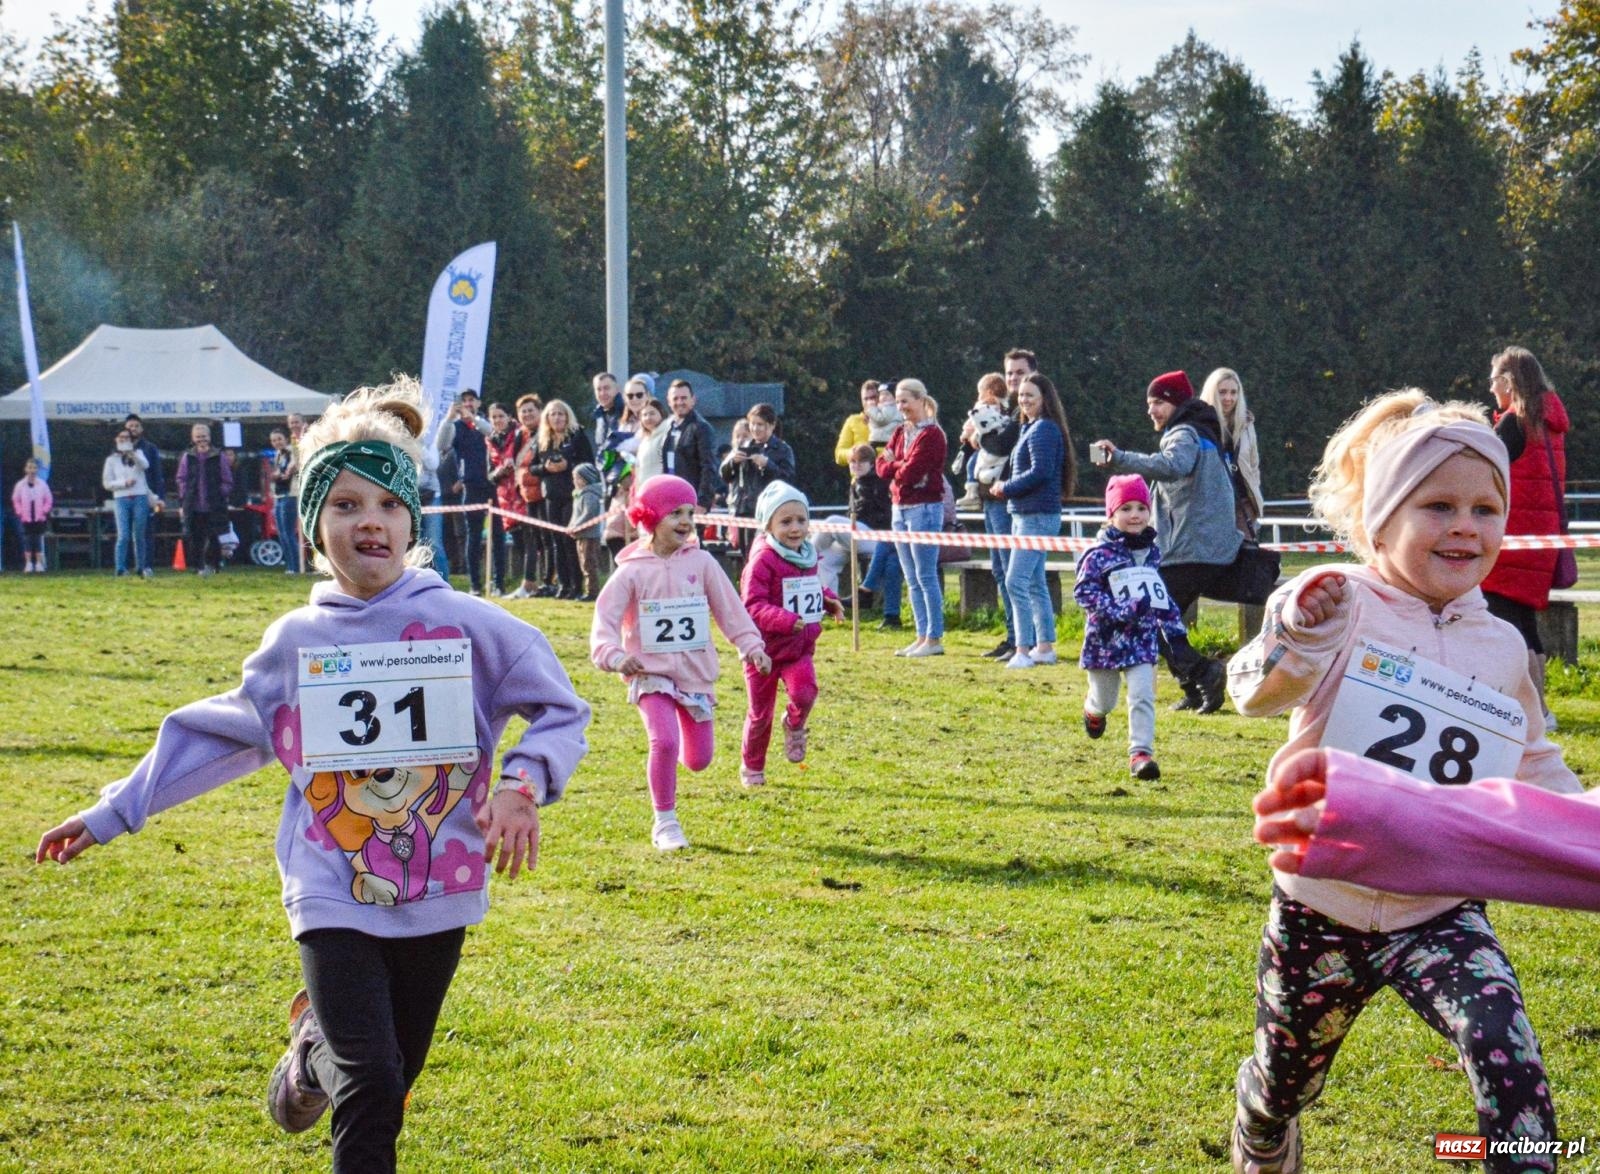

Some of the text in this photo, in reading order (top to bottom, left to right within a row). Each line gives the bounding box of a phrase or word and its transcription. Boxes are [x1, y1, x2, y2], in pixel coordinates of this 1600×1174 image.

[56, 401, 286, 415] STOWARZYSZENIE AKTYWNI DLA LEPSZEGO JUTRA
[788, 592, 822, 614] 122
[1118, 581, 1165, 601] 116
[655, 617, 696, 643] 23
[360, 652, 465, 669] www.personalbest.pl
[1420, 675, 1523, 728] www.personalbest.pl
[338, 686, 427, 746] 31
[1363, 703, 1480, 785] 28
